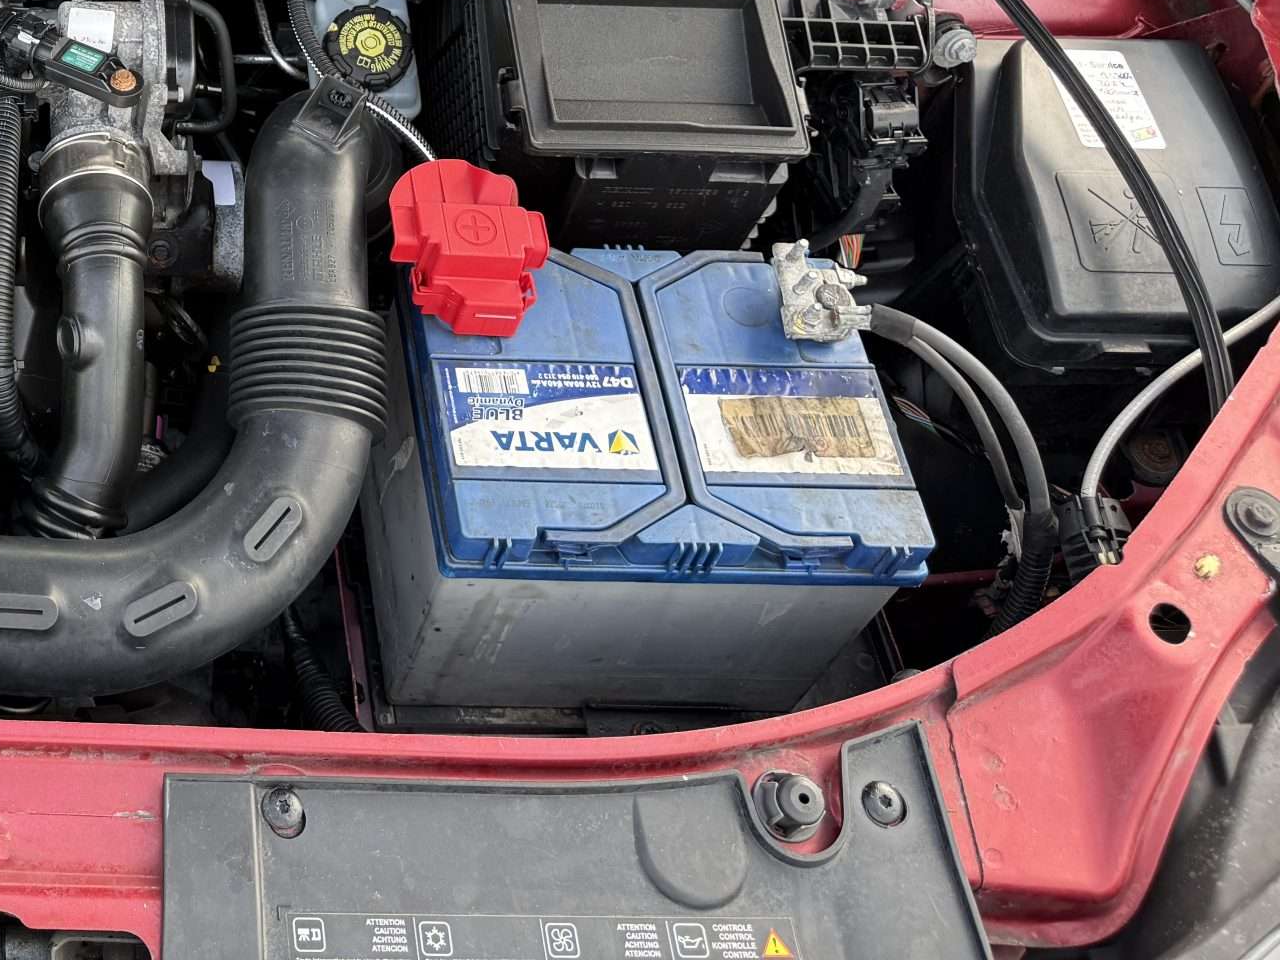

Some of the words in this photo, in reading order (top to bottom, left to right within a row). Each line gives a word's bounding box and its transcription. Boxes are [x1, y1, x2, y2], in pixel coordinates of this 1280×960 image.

[371, 48, 402, 72] WARNING
[602, 376, 634, 388] D47
[468, 396, 524, 408] Dynamic
[472, 407, 523, 420] BLUE
[489, 431, 602, 452] VARTA
[374, 927, 406, 935] CAUTION
[616, 923, 656, 931] ATTENTION
[711, 924, 753, 932] CONTROLE
[372, 936, 407, 944] ACHTUNG
[625, 932, 658, 940] CAUTION
[718, 933, 756, 941] CONTROL
[624, 941, 660, 949] ACHTUNG
[711, 942, 758, 950] KONTROLLE
[624, 950, 662, 958] ATENCION
[722, 951, 760, 959] CONTROL
